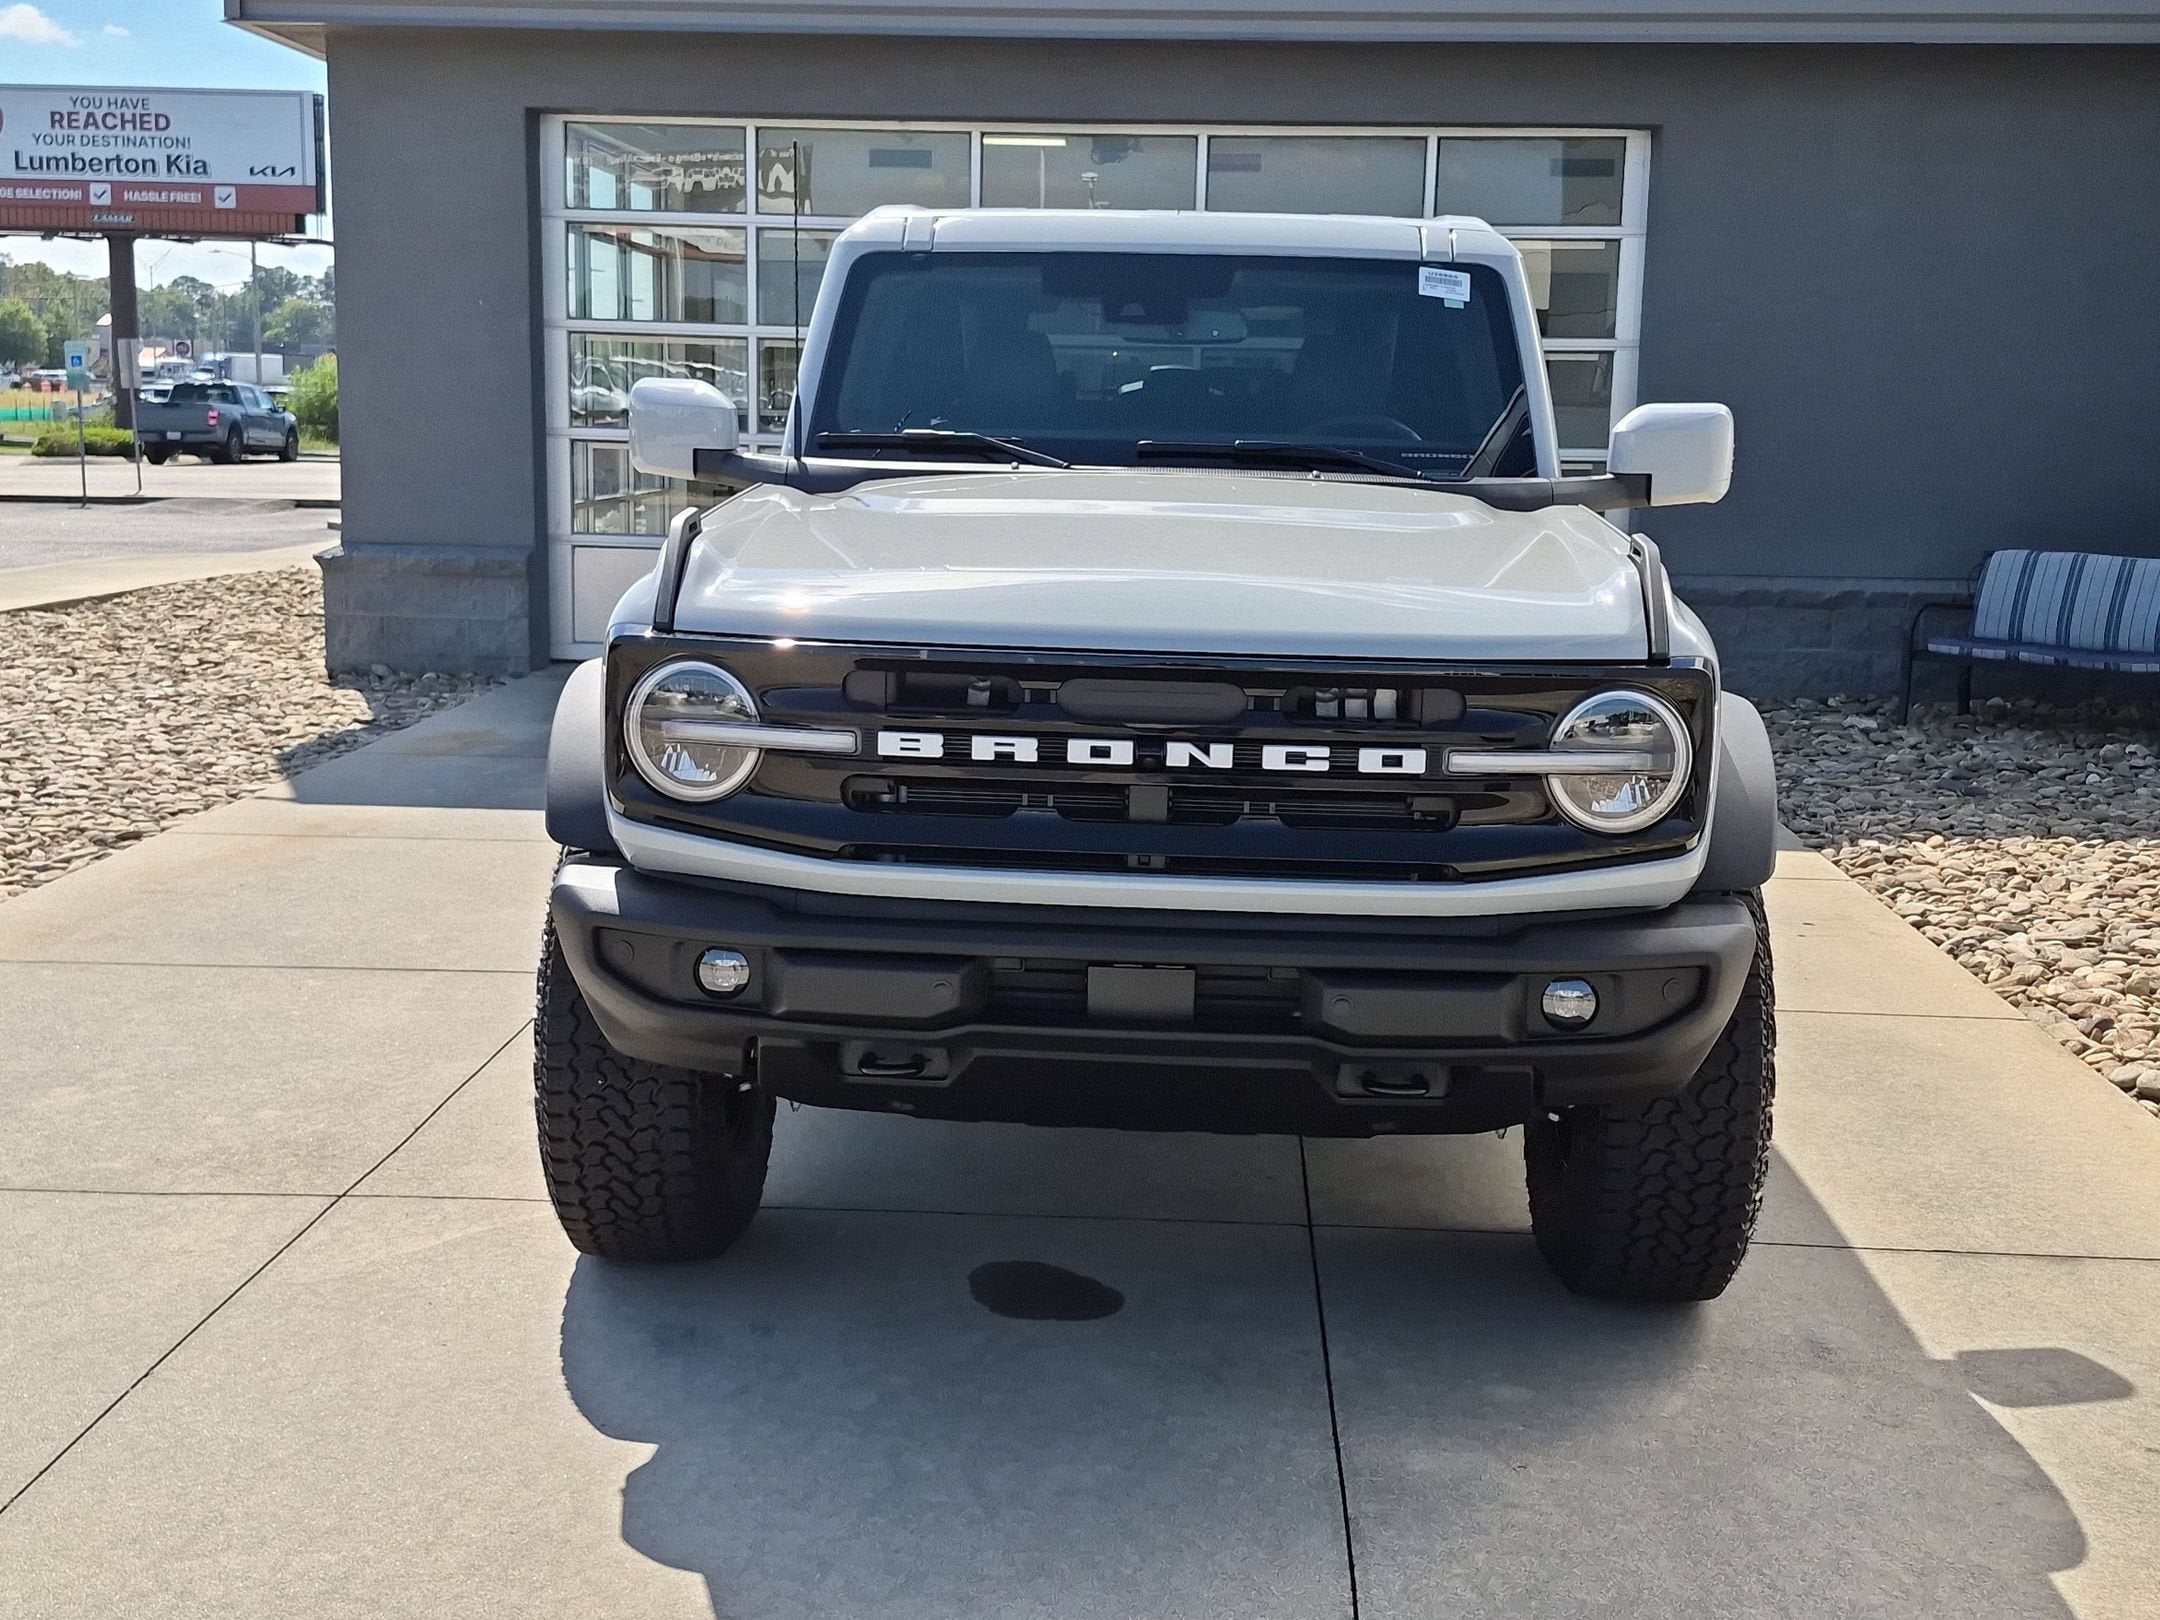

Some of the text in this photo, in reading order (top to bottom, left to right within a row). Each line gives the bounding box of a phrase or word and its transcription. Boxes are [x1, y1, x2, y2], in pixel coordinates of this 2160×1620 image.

[69, 95, 150, 110] YOU HAVE
[50, 111, 171, 132] REACHED
[32, 133, 191, 149] YOUR DESTINATION!
[14, 150, 210, 176] Lumberton Kia
[877, 730, 1427, 774] BRONCO
